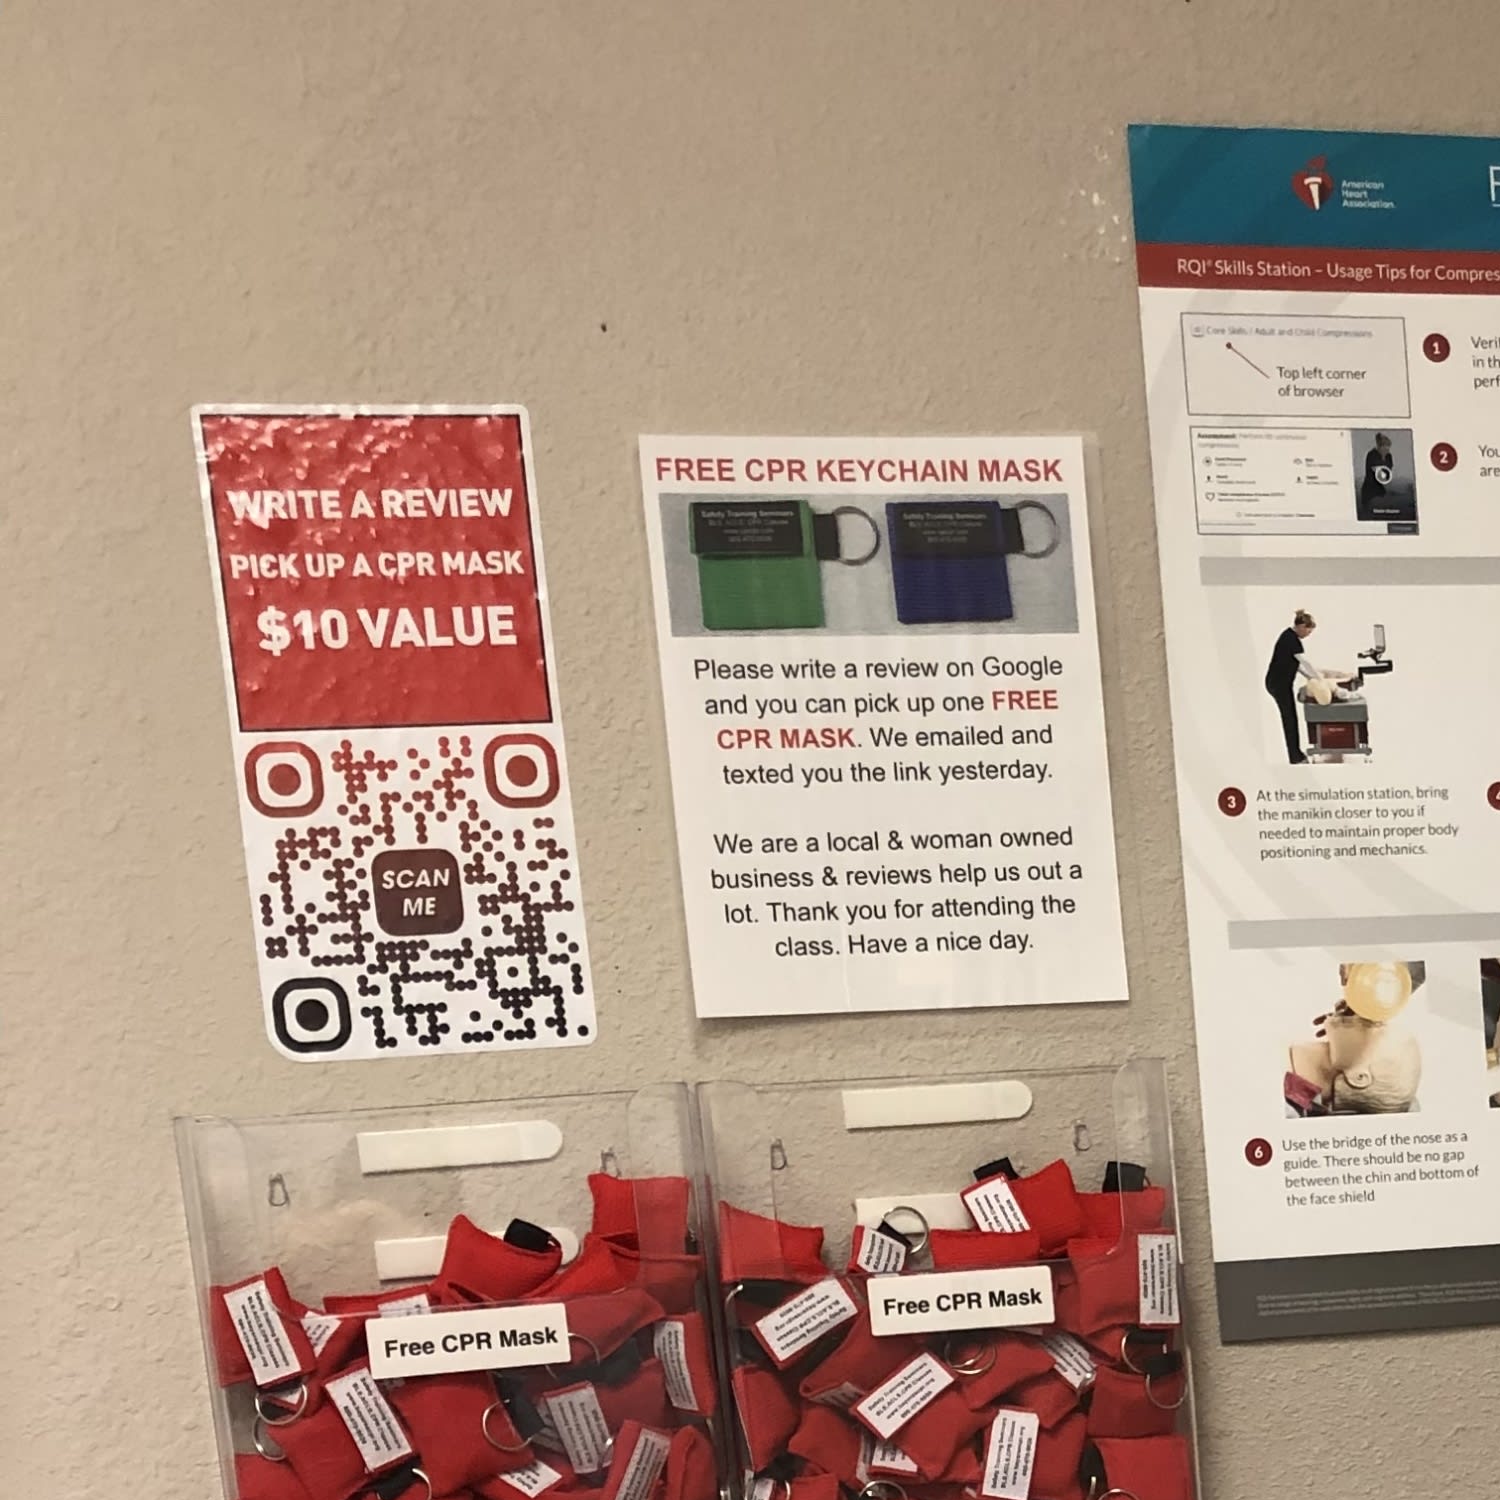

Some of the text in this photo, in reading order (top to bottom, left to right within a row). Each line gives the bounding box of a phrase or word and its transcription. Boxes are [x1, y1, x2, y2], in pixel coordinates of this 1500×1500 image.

[1341, 180, 1384, 190] American
[1341, 189, 1369, 199] Heart
[1214, 258, 1254, 277] Skills
[1256, 259, 1312, 277] Station
[1326, 262, 1373, 282] Usage
[1374, 263, 1407, 282] Tips
[1409, 264, 1432, 280] for
[1275, 365, 1367, 382] Top left corner
[1277, 383, 1345, 398] of browser
[655, 457, 1063, 483] FREE CPR KEYCHAIN MASK
[227, 488, 513, 523] WRITE A REVIEW
[229, 549, 526, 580] PICK UP A CPR MASK
[257, 605, 518, 656] $10 VALUE
[693, 655, 1063, 681] Please write a review on Google
[704, 689, 1059, 720] and you can pick up one FREE
[716, 723, 1053, 750] CPR MASK. We emailed and
[381, 868, 451, 889] SCAN
[402, 896, 437, 918] ME
[882, 1287, 1043, 1316] Free CPR Mask
[383, 1325, 559, 1358] Free CPR Mask
